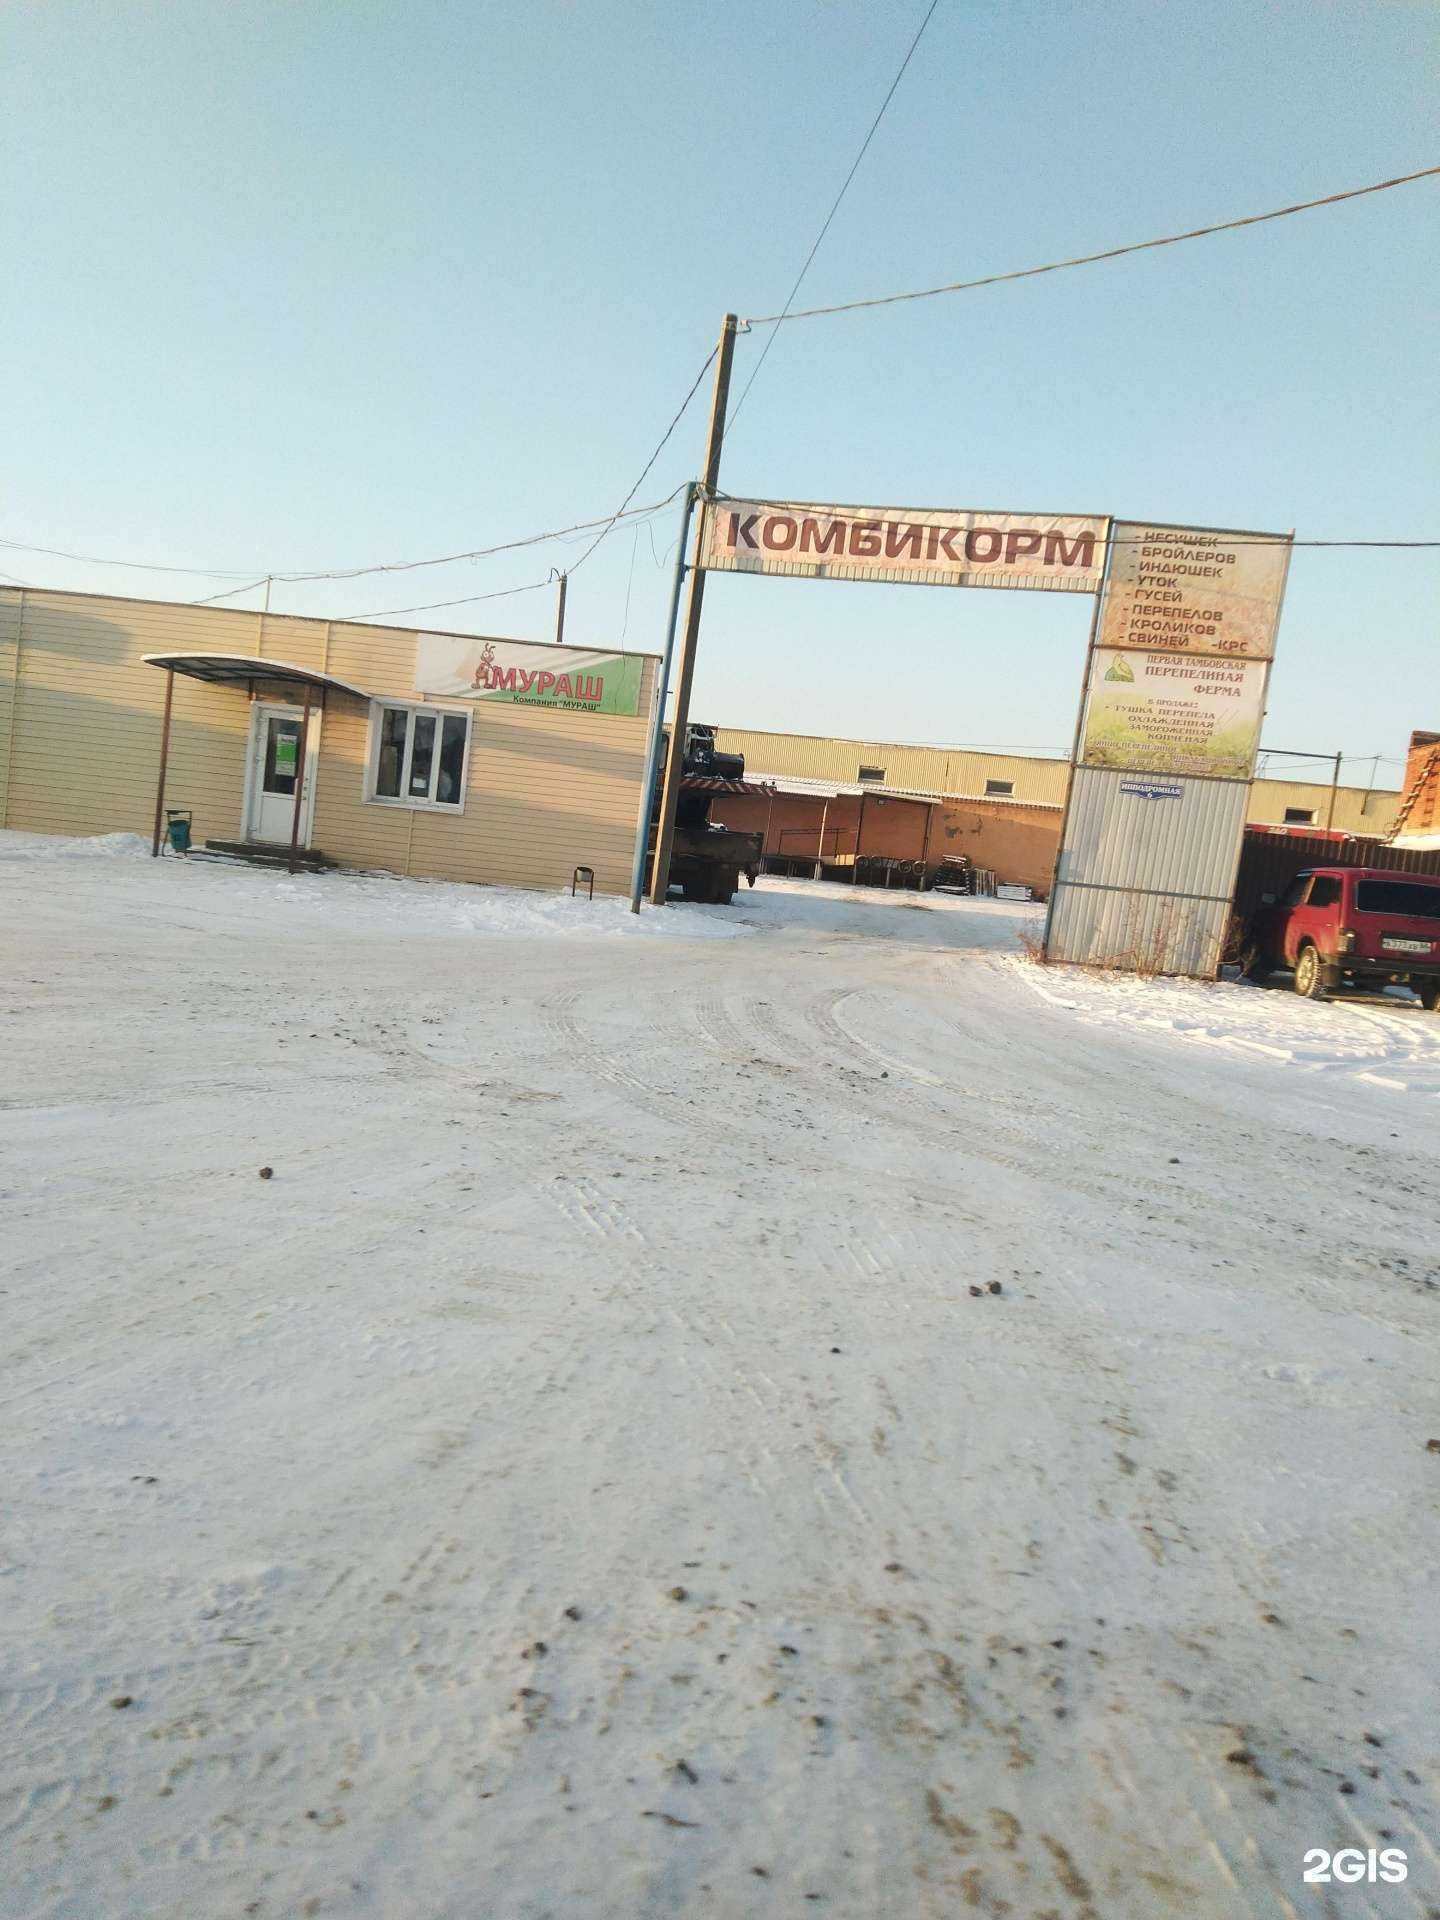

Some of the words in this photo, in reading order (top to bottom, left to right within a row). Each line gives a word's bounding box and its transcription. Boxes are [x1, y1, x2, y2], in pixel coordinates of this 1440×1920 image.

[726, 512, 1096, 567] КОМБИКОРМ
[1141, 546, 1236, 564] БРОЙЛЕРОВ
[1139, 560, 1223, 578] ИНДЮШЕК
[1138, 574, 1178, 588] УТОК
[1134, 588, 1183, 602] ГУСЕЙ
[1132, 604, 1223, 621] ПЕРЕПЕЛОВ
[1130, 618, 1216, 636] КРОЛИКОВ
[1128, 632, 1190, 647] СВИНЕЙ
[1146, 654, 1183, 666] ПЕРВАЯ
[1186, 658, 1247, 670] ТАМБОВСКАЯ
[1145, 666, 1245, 682] ПЕРЕПЕЛИНАЯ
[491, 664, 604, 703] МУРАШ
[1193, 684, 1241, 697] ФЕРМА
[559, 700, 601, 711] "МУРАШ"
[1115, 704, 1153, 714] ТУШКА
[1158, 708, 1216, 720] ПЕРЕПЕЛА
